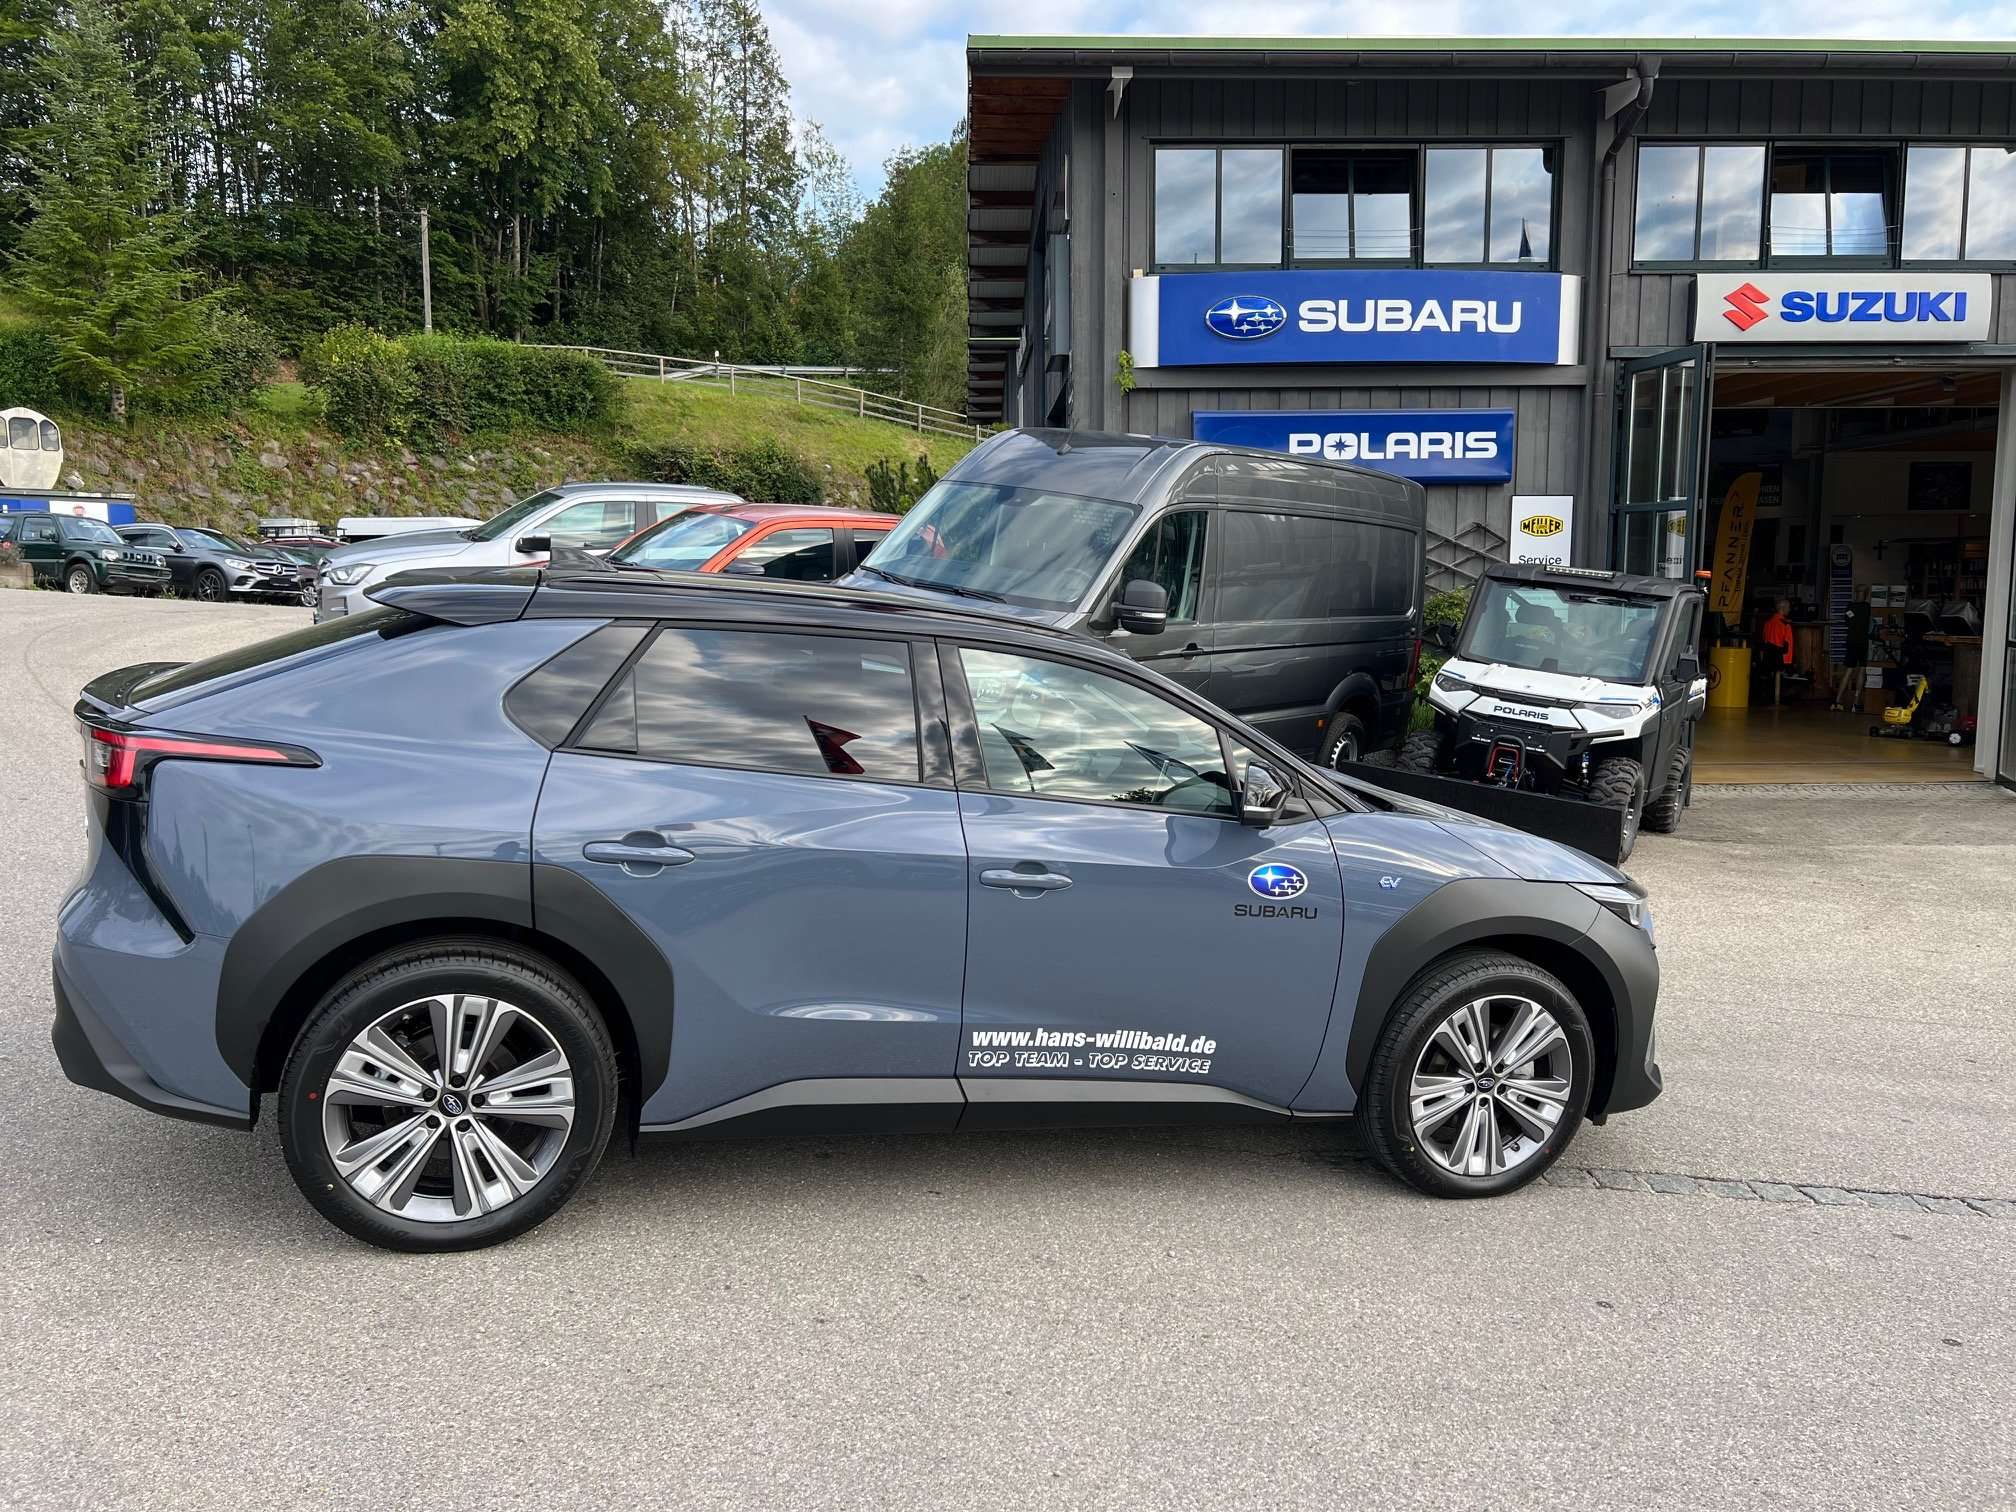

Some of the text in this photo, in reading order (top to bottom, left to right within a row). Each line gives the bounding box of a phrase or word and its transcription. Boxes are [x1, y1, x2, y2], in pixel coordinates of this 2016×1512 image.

[1298, 299, 1522, 334] SUBARU
[1780, 291, 1968, 322] SUZUKI
[1288, 431, 1498, 460] POLARIS
[1522, 517, 1561, 535] MEILLER
[1518, 554, 1562, 565] Service
[1493, 705, 1549, 720] POLARIS
[1234, 904, 1318, 919] SUBARU
[972, 1027, 1217, 1054] www.hans-willibald.de
[968, 1051, 1010, 1067] TOP
[1015, 1051, 1070, 1068] TEAM
[1088, 1053, 1128, 1069] TOP
[1131, 1054, 1211, 1074] SERVICE
